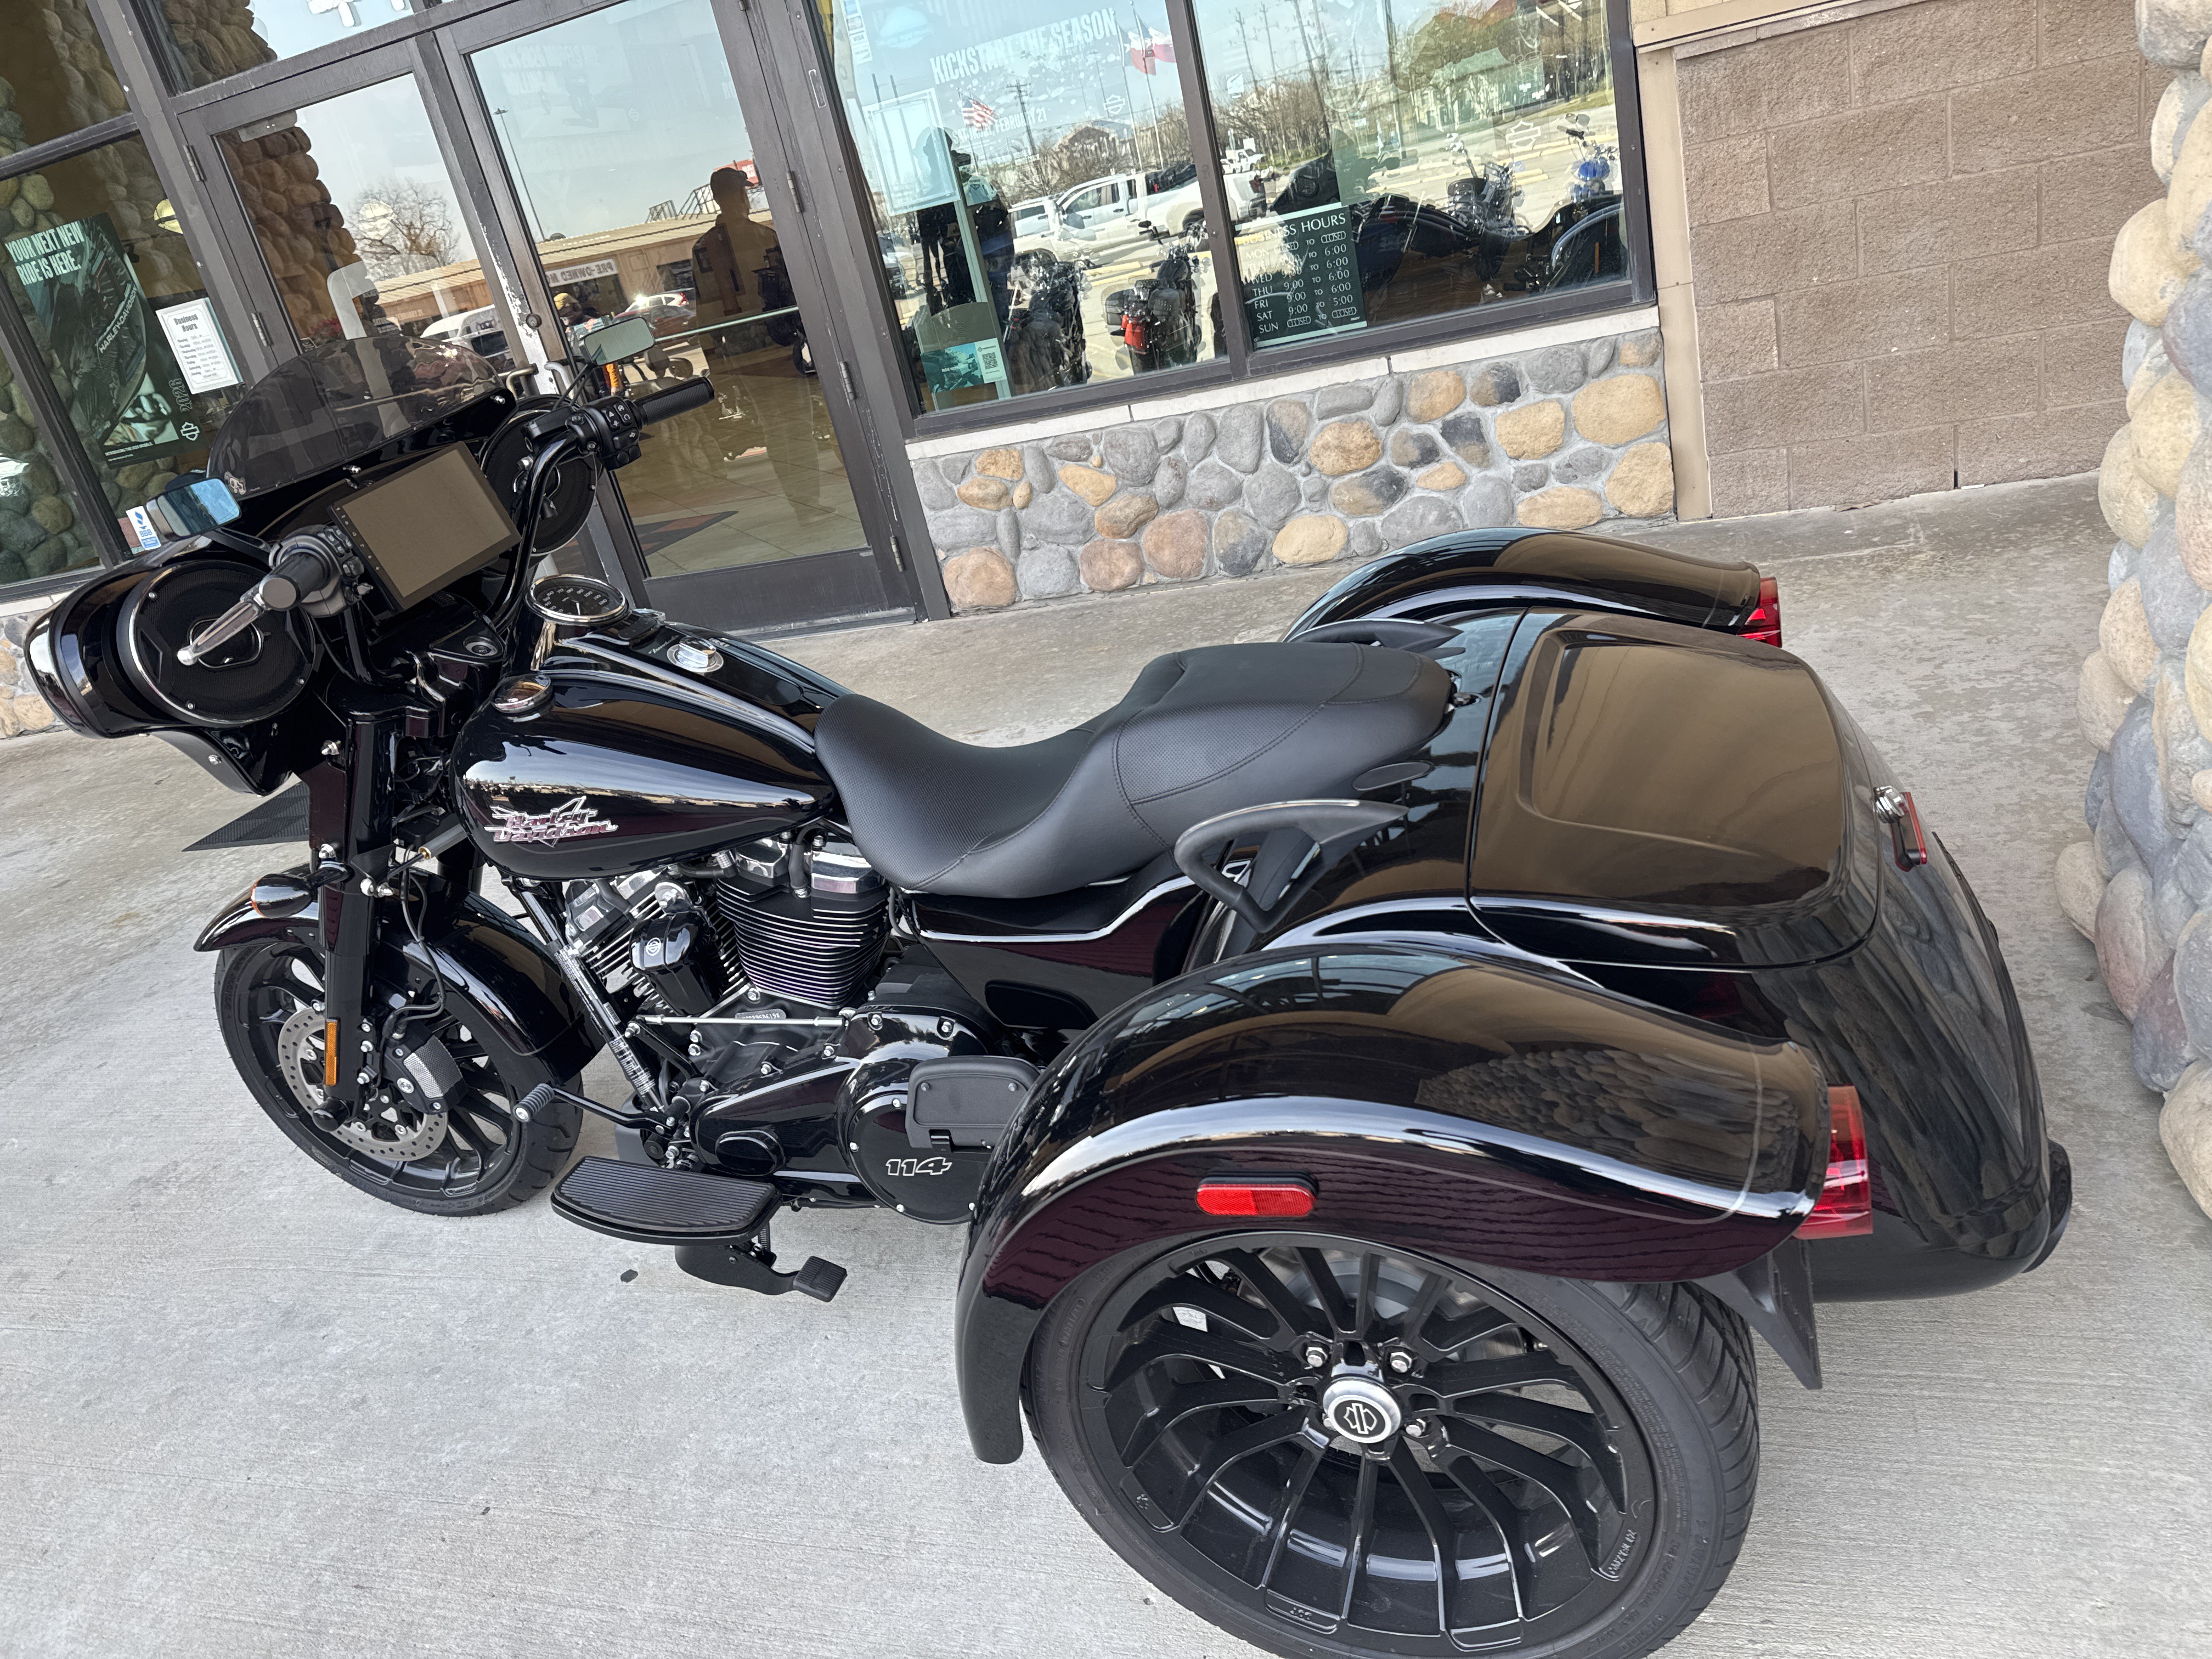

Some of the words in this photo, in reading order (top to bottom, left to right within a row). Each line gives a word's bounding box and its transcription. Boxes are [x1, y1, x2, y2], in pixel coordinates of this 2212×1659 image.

[1050, 7, 1117, 50] SEASON
[1036, 107, 1047, 123] 21
[1301, 213, 1346, 232] HOURS
[4, 236, 36, 263] YOUR
[31, 229, 61, 255] NEXT
[56, 221, 84, 247] NEW
[1321, 231, 1346, 244] CLOSED
[1324, 244, 1347, 256] 6:00
[15, 259, 43, 286] RIDE
[37, 257, 54, 280] IS
[48, 250, 82, 276] HERE.
[1327, 257, 1348, 269] 6:00
[1252, 285, 1273, 297] THU
[1284, 279, 1304, 290] 9:00
[1328, 269, 1350, 281] 6:00
[1254, 299, 1269, 309] FRI
[1286, 291, 1306, 303] 9:00
[1331, 282, 1351, 294] 6:00
[1257, 311, 1273, 321] SAT
[1288, 303, 1308, 315] 9:00
[1333, 295, 1353, 306] 5:00
[99, 285, 137, 354] HARLEY-DAVIDSON
[173, 314, 199, 325] Business
[181, 323, 198, 332] Hours
[1259, 322, 1279, 334] SUN
[1286, 315, 1312, 328] CLOSED
[1331, 307, 1357, 319] CLOSED
[139, 529, 153, 537] BBB
[484, 820, 620, 843] Davidson
[885, 1156, 952, 1176] 114
